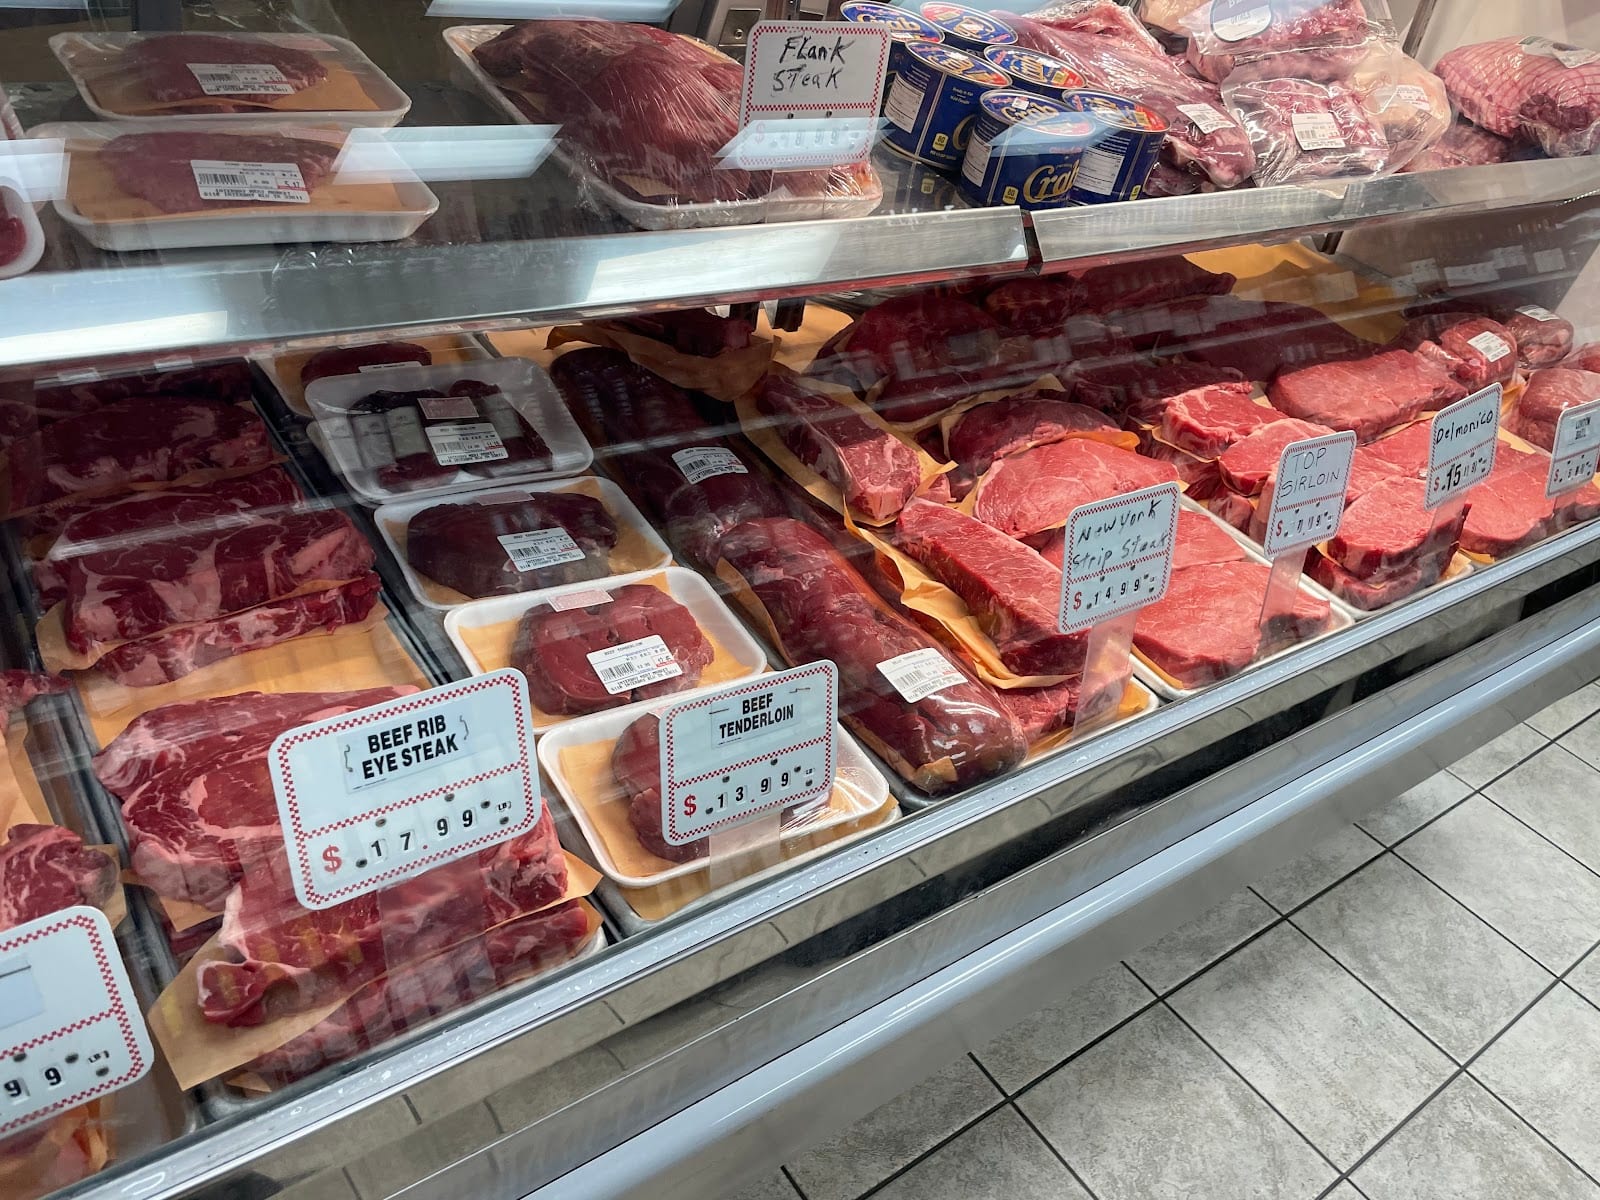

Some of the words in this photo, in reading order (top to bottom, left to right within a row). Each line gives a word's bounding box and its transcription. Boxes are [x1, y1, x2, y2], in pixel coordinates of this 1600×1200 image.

[1436, 410, 1494, 445] Delmonico
[1292, 447, 1327, 473] TOP
[1280, 467, 1340, 498] SIRLOIN
[742, 693, 774, 714] BEEF
[367, 724, 413, 754] BEEF
[417, 714, 447, 739] RIB
[719, 704, 794, 739] TENDERLOIN
[362, 752, 398, 779] EYE
[401, 733, 459, 767] STEAK
